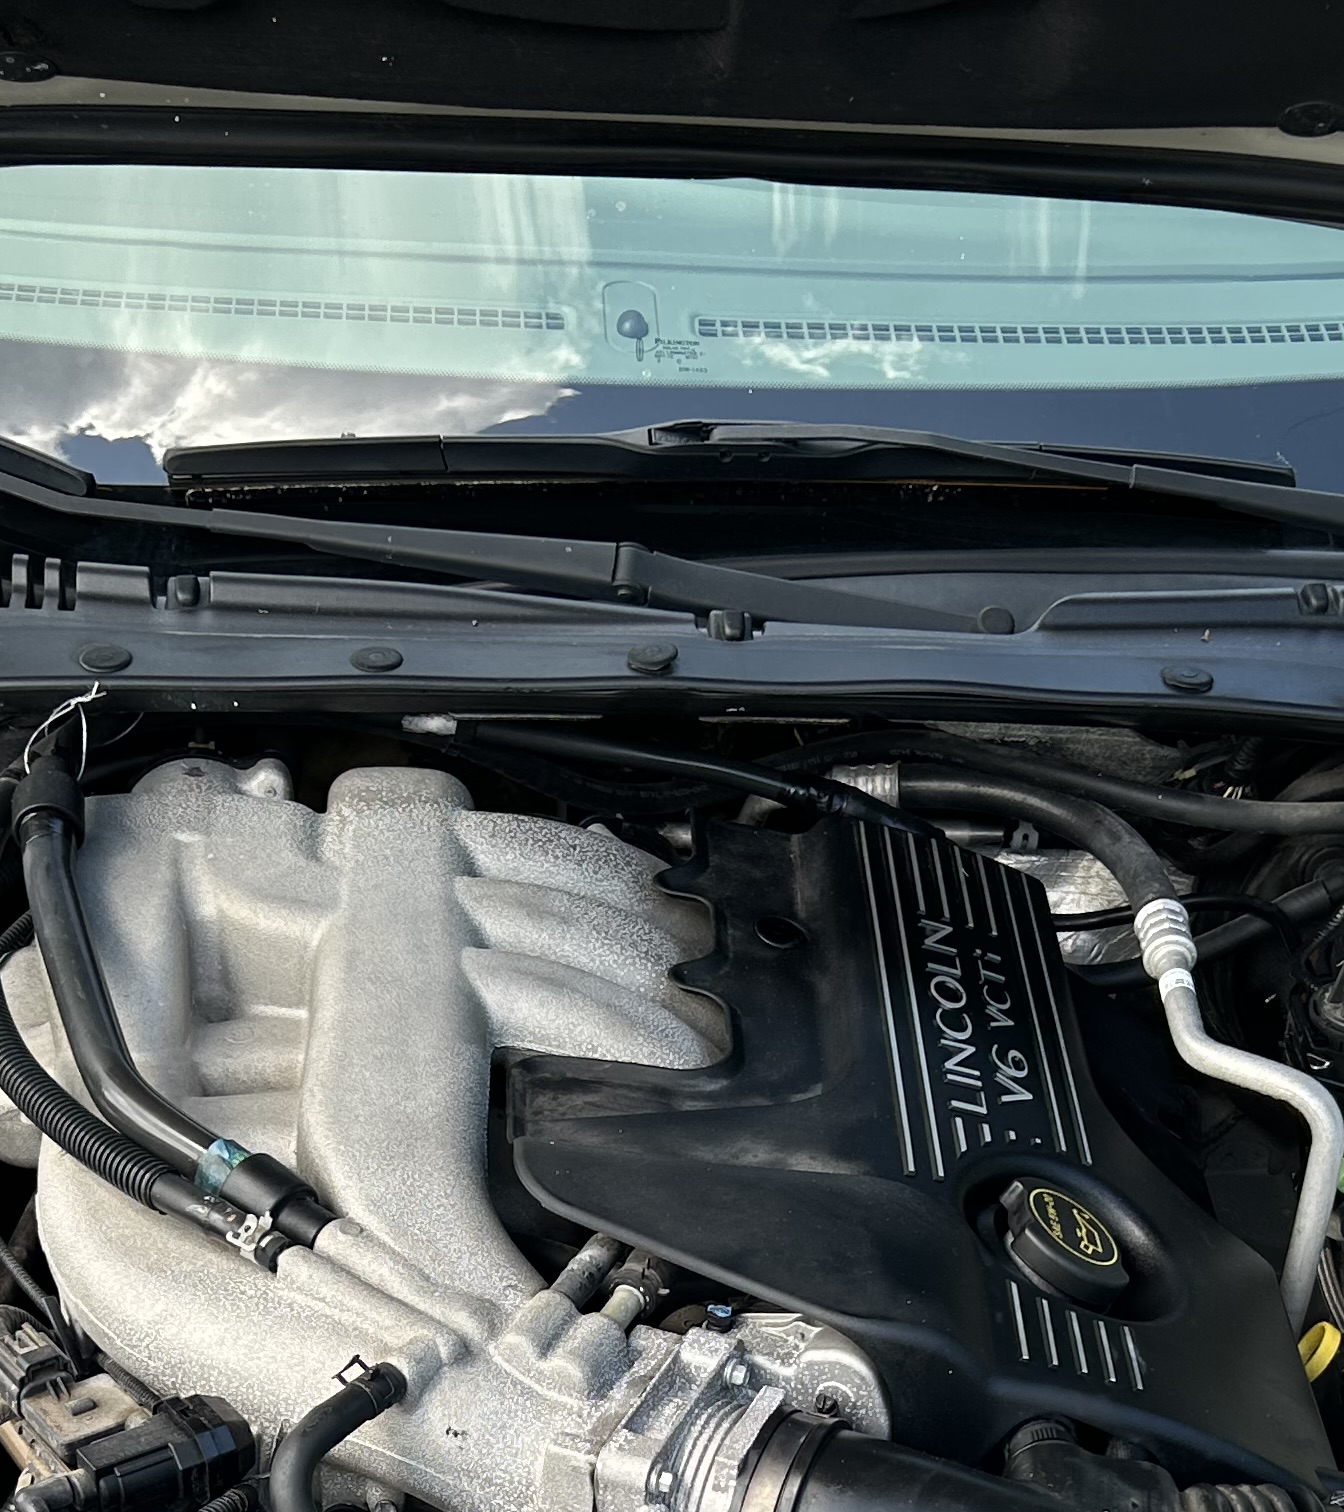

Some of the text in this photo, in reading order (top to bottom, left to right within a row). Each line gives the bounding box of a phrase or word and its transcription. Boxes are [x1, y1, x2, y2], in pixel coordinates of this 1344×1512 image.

[920, 920, 987, 1116] LINCOLN
[971, 948, 1034, 1106] V6 VCTi
